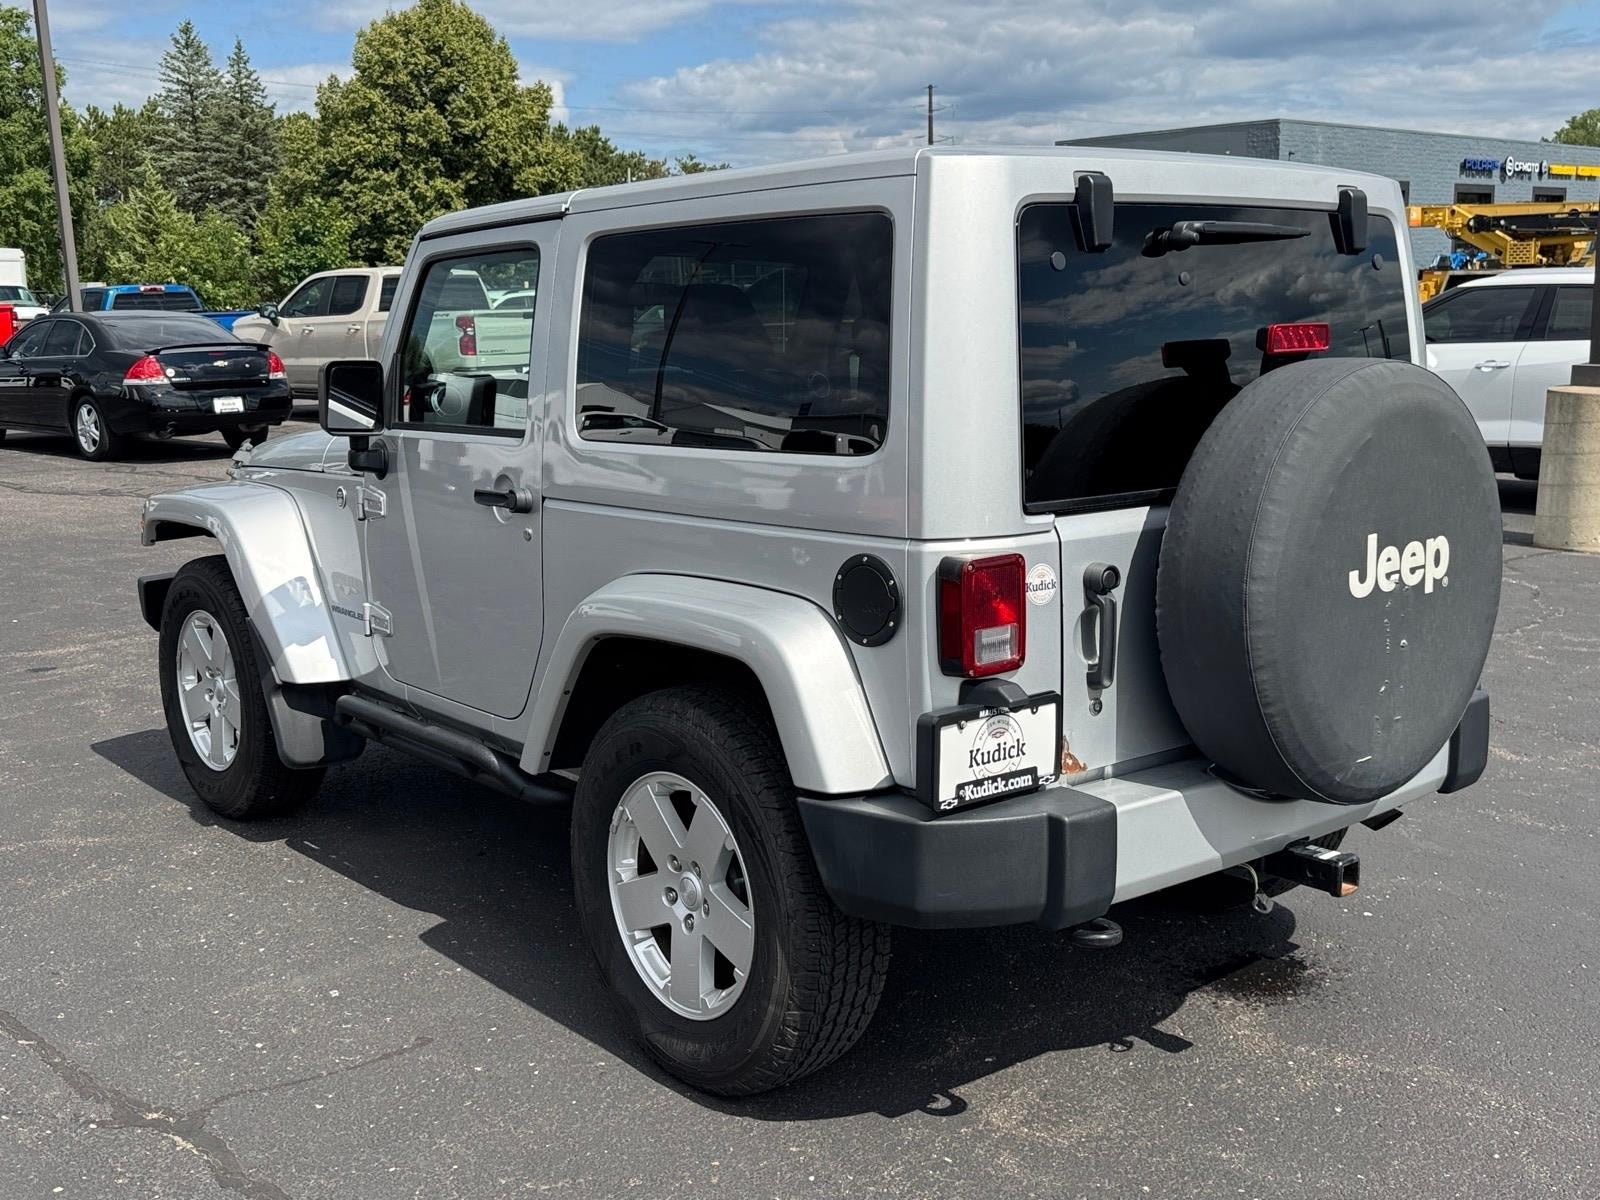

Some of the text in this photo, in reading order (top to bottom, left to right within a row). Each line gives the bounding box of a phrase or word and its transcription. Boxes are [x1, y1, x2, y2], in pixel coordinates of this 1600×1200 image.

[1348, 533, 1450, 599] Jeep
[1025, 579, 1057, 593] Kudick
[968, 738, 1027, 769] Kudick
[964, 774, 1033, 801] Kudick.com
